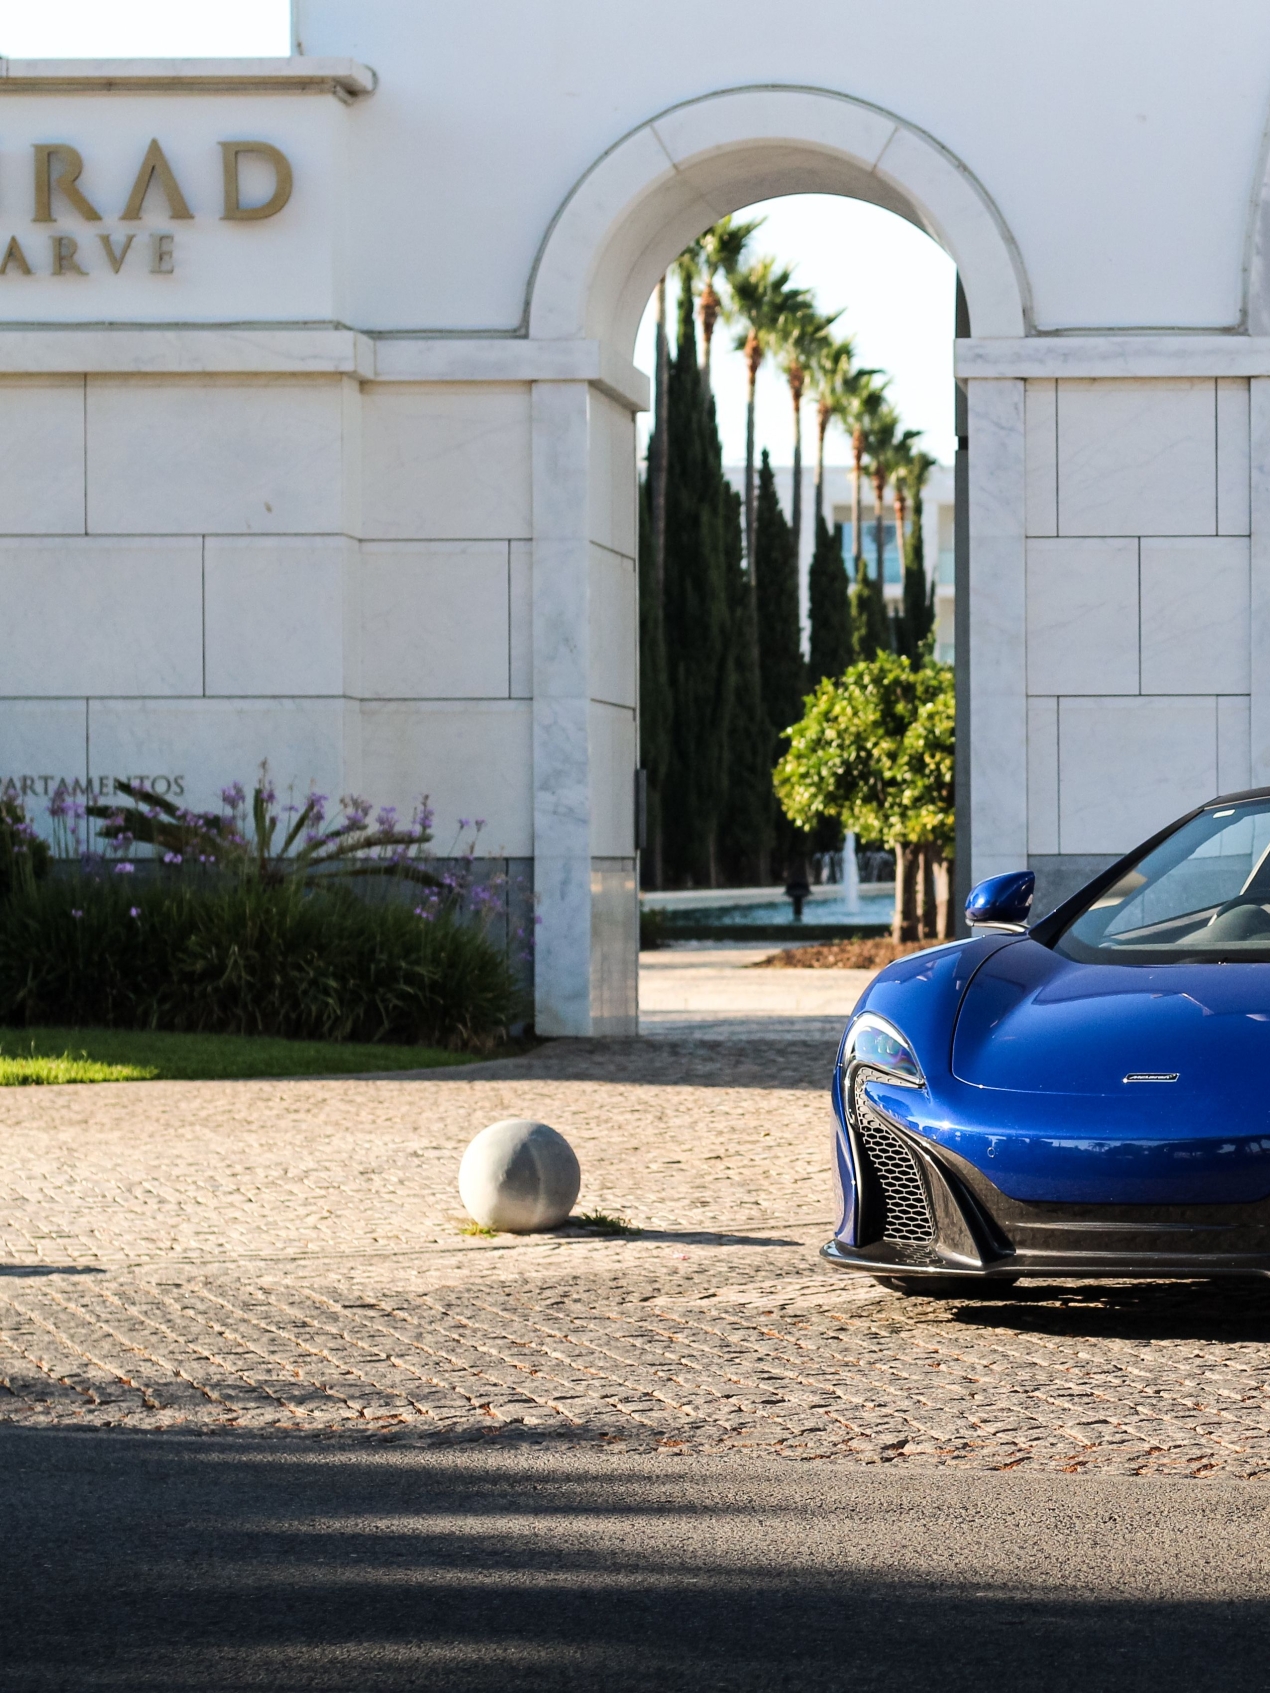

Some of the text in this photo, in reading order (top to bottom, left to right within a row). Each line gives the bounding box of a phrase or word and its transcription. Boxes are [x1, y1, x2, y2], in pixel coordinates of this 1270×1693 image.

[30, 138, 293, 222] RAD
[0, 234, 174, 275] ARVE
[0, 774, 185, 796] ARTAMENTOS
